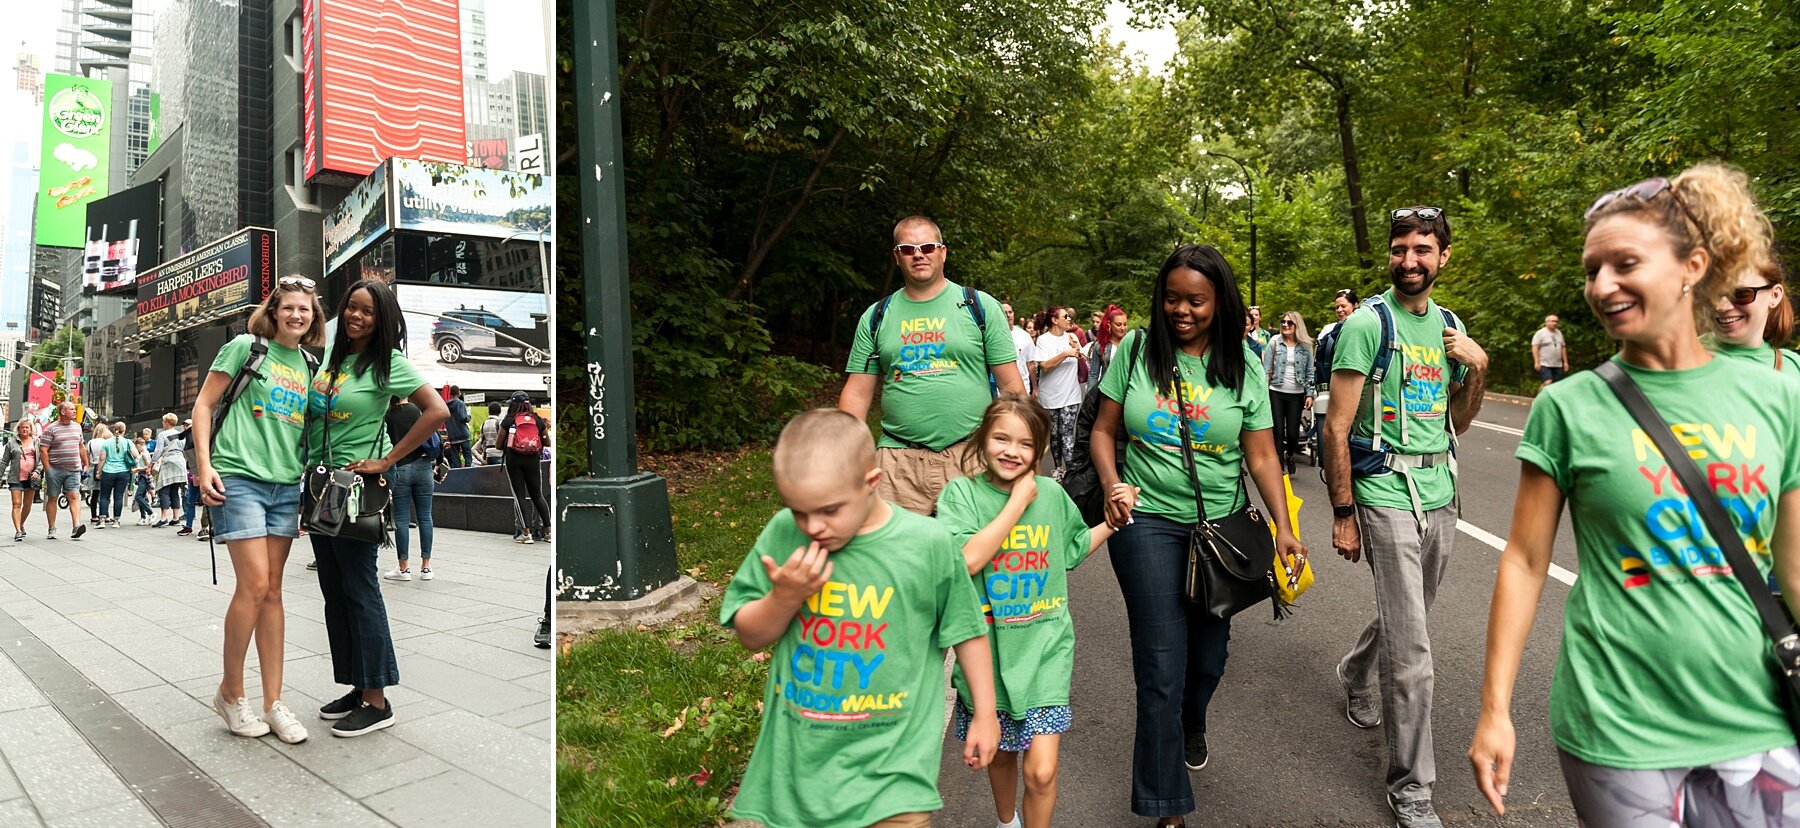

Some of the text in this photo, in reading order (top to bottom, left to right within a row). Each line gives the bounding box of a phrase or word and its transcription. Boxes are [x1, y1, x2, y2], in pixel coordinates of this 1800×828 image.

[58, 110, 101, 125] Green
[62, 120, 103, 135] Giant
[404, 195, 445, 214] utility
[196, 243, 223, 262] AMERICAN
[157, 270, 193, 296] HARPER
[195, 257, 223, 282] LEE'S
[138, 301, 149, 315] TO
[150, 294, 170, 312] KILL
[171, 291, 177, 304] A
[179, 264, 249, 302] MOCKINGBIRD
[901, 317, 946, 333] NEW
[901, 331, 946, 345] YORK
[900, 343, 946, 362] CITY
[1401, 342, 1441, 365] NEW
[270, 361, 304, 383] NEW
[1405, 363, 1442, 381] YORK
[273, 375, 306, 396] YORK
[270, 386, 307, 411] CITY
[1154, 394, 1210, 420] YORK
[1147, 410, 1211, 442] CIY
[1645, 497, 1767, 541] CIY
[992, 550, 1050, 572] YORK
[985, 571, 1048, 600] CITY
[992, 598, 1062, 617] UDDYWALK
[797, 611, 888, 650] YORK
[791, 644, 884, 690] CITY
